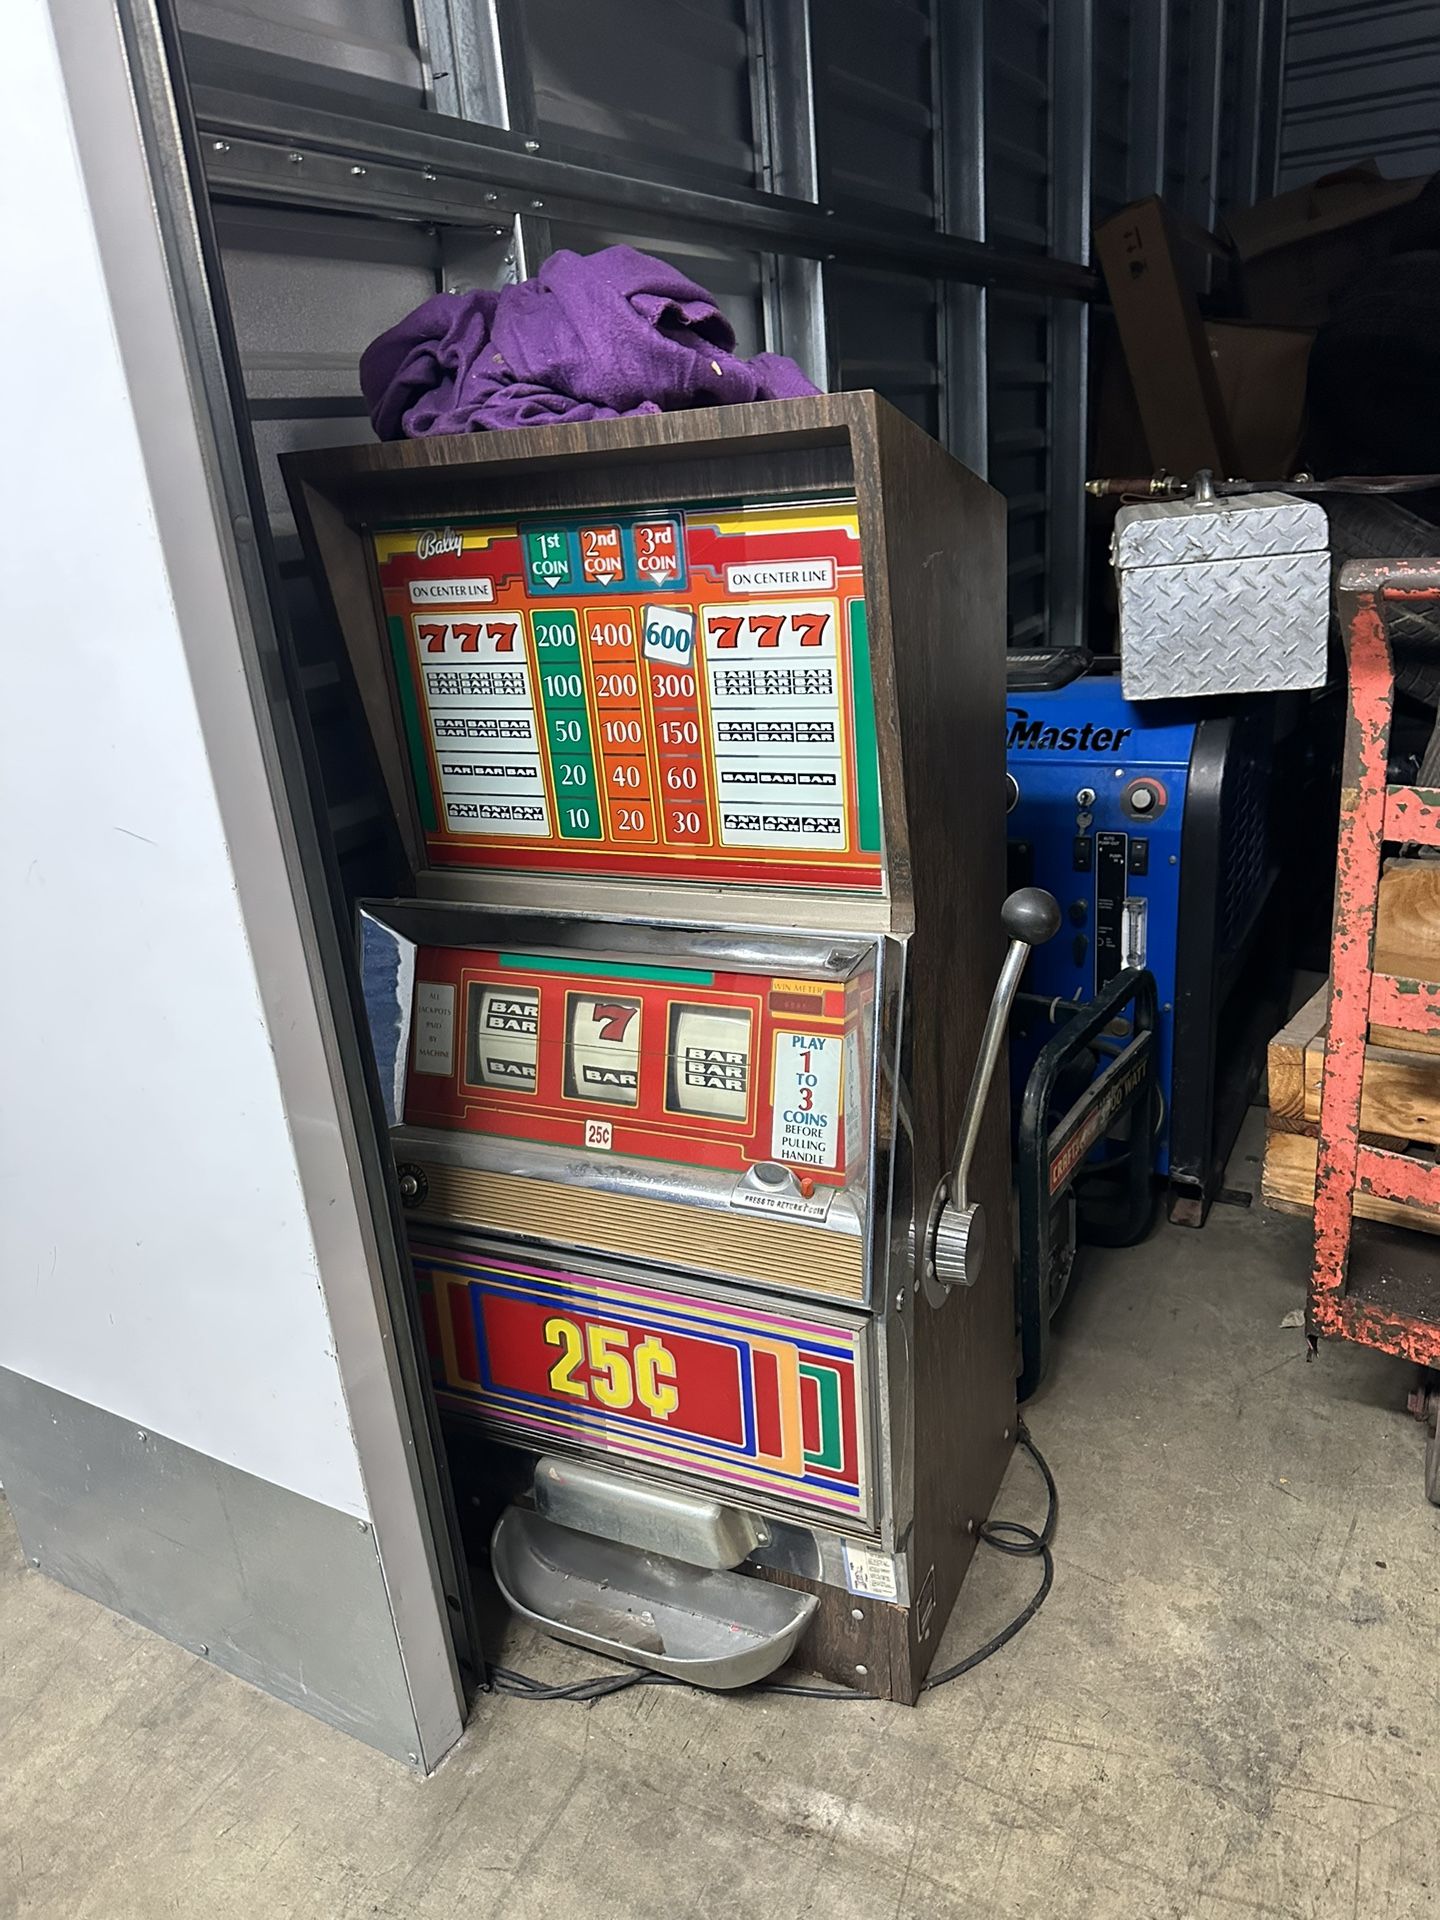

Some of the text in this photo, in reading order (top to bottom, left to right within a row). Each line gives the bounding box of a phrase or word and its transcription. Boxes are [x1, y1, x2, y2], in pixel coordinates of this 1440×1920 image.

[417, 527, 463, 560] Bally
[537, 533, 560, 559] 1st
[584, 529, 617, 557] 2nd
[640, 527, 672, 554] 3rd
[532, 561, 568, 575] COIN
[584, 557, 622, 572] COIN
[638, 555, 676, 570] COIN
[733, 570, 827, 585] ON CENTER LINE
[413, 585, 488, 598] ON CENTER LINE
[535, 624, 576, 647] 200
[590, 623, 632, 646] 400
[646, 622, 691, 652] 600
[543, 674, 582, 697] 100
[595, 674, 637, 697] 200
[652, 674, 695, 698] 300
[435, 719, 529, 729] BAR BAR BAR
[555, 720, 581, 742] 50
[602, 720, 642, 743] 100
[719, 723, 832, 731] BAR BAR BAR
[437, 729, 530, 738] BAR BAR BAR
[658, 721, 698, 744] 150
[720, 733, 833, 741] BAR BAR BAR
[443, 766, 536, 776] BAR BAR BAR
[559, 764, 587, 786] 20
[612, 765, 640, 788] 40
[667, 767, 697, 790] 60
[723, 774, 835, 784] BAR BAR BAR
[448, 810, 478, 818] BAR
[481, 811, 510, 819] BAR
[513, 806, 541, 814] ANY
[566, 808, 590, 829] 10
[617, 809, 645, 831] 20
[672, 811, 700, 834] 30
[804, 818, 838, 826] ANY
[725, 822, 840, 833] BAR BAR BAR
[774, 983, 822, 993] WIN METER
[419, 1006, 451, 1016] JACKPOTS
[490, 1001, 538, 1017] BAR
[488, 1017, 537, 1033] BAR
[592, 1003, 638, 1043] 7
[792, 1035, 826, 1051] PLAY
[419, 1048, 449, 1058] MACHINE
[688, 1049, 744, 1064] BAR
[490, 1062, 537, 1077] BAR
[800, 1050, 811, 1073] 1
[585, 1069, 637, 1086] BAR
[688, 1062, 743, 1078] BAR
[688, 1075, 743, 1091] BAR
[796, 1072, 817, 1087] TO
[798, 1088, 813, 1112] 3
[783, 1110, 828, 1128] COINS
[588, 1125, 610, 1144] 25¢
[785, 1124, 823, 1139] BEFORE
[782, 1137, 826, 1152] PULLING
[781, 1149, 824, 1165] HANDLE
[745, 1195, 765, 1205] PRESS
[767, 1198, 775, 1207] TO
[543, 1316, 679, 1421] 25¢
